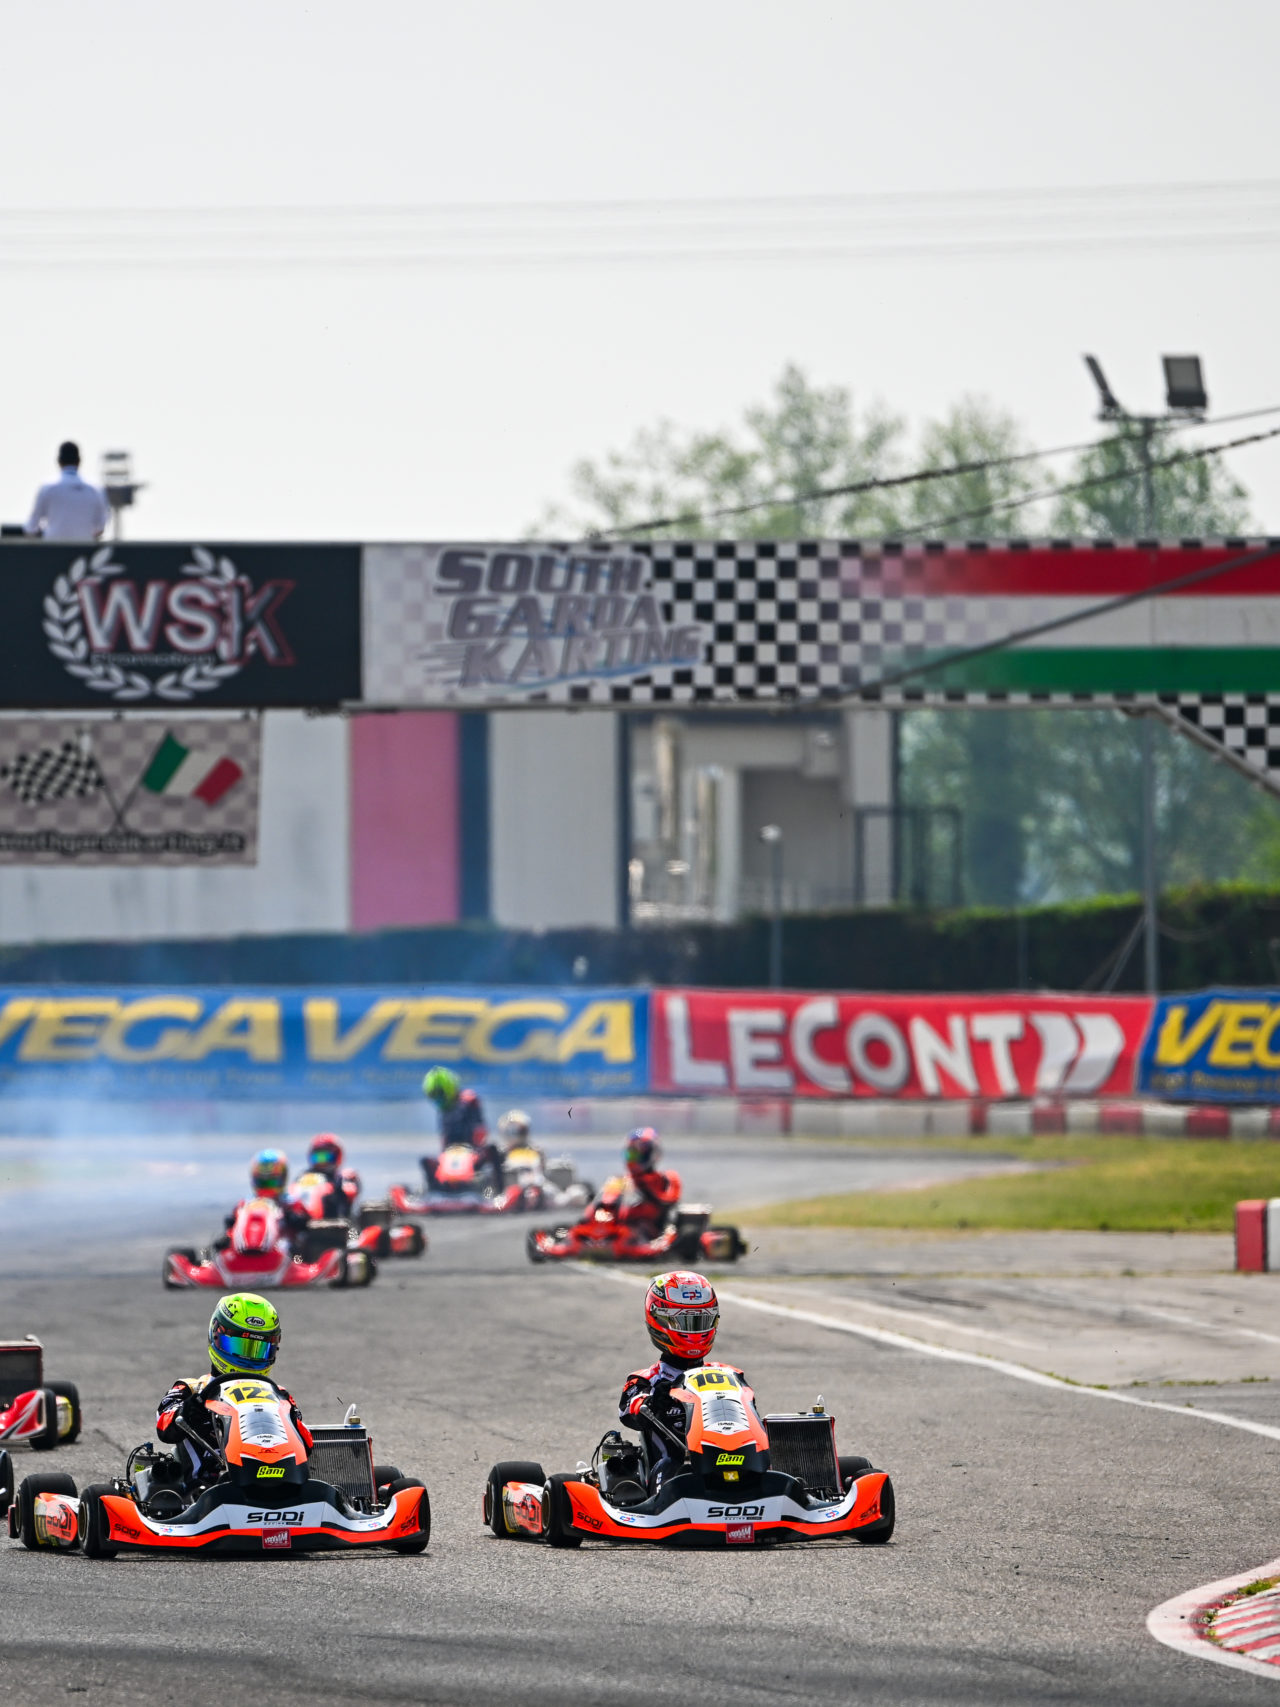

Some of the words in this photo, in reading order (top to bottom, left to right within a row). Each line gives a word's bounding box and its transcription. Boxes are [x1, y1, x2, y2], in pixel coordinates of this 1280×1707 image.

[434, 550, 644, 594] SOUTH
[78, 579, 297, 665] WSK
[447, 595, 662, 641] GARDA
[460, 625, 704, 687] KARTING
[305, 996, 635, 1063] VEGA
[692, 1372, 737, 1389] 101
